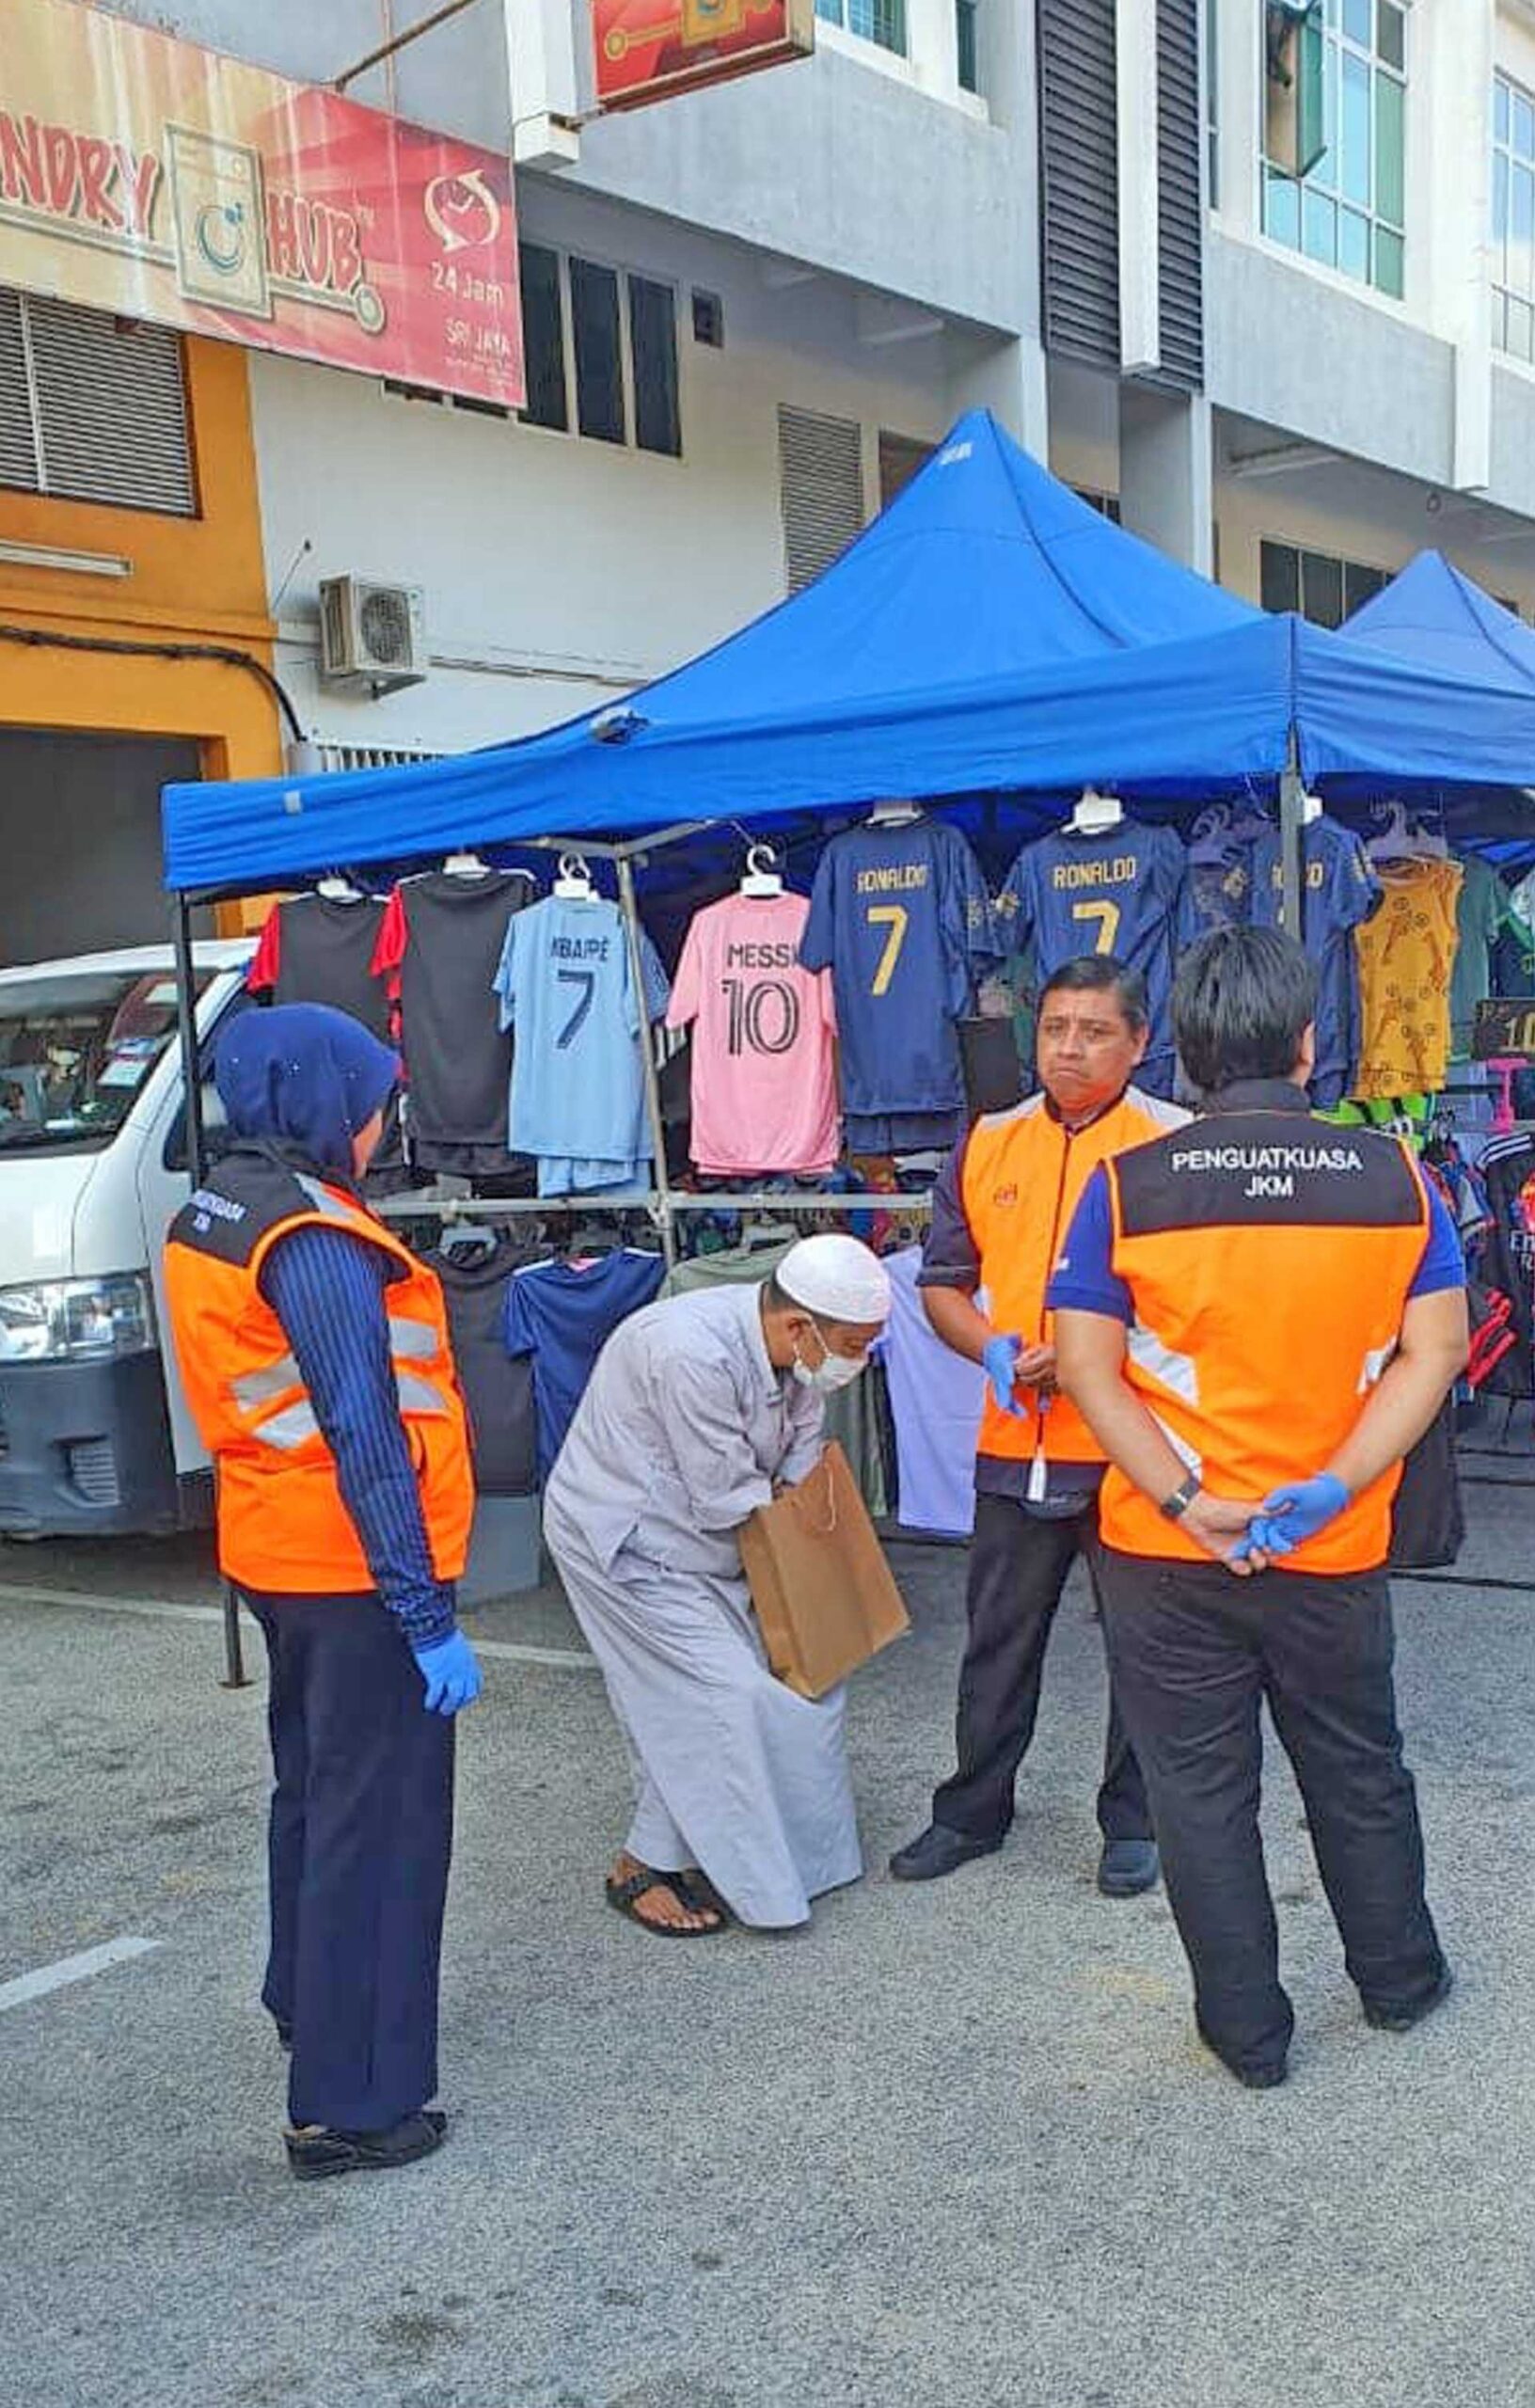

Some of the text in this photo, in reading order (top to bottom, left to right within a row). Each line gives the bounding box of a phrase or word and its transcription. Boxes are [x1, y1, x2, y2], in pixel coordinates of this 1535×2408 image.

[267, 192, 360, 293] HUB
[432, 261, 504, 309] 24 Jam
[1053, 856, 1136, 890] RONALDO
[867, 905, 909, 997] 7
[1072, 900, 1121, 956] 7
[557, 969, 593, 1050] 7
[721, 979, 799, 1055] 10
[1172, 1147, 1364, 1172] PENGUATKUASA
[1244, 1175, 1294, 1197] JKM
